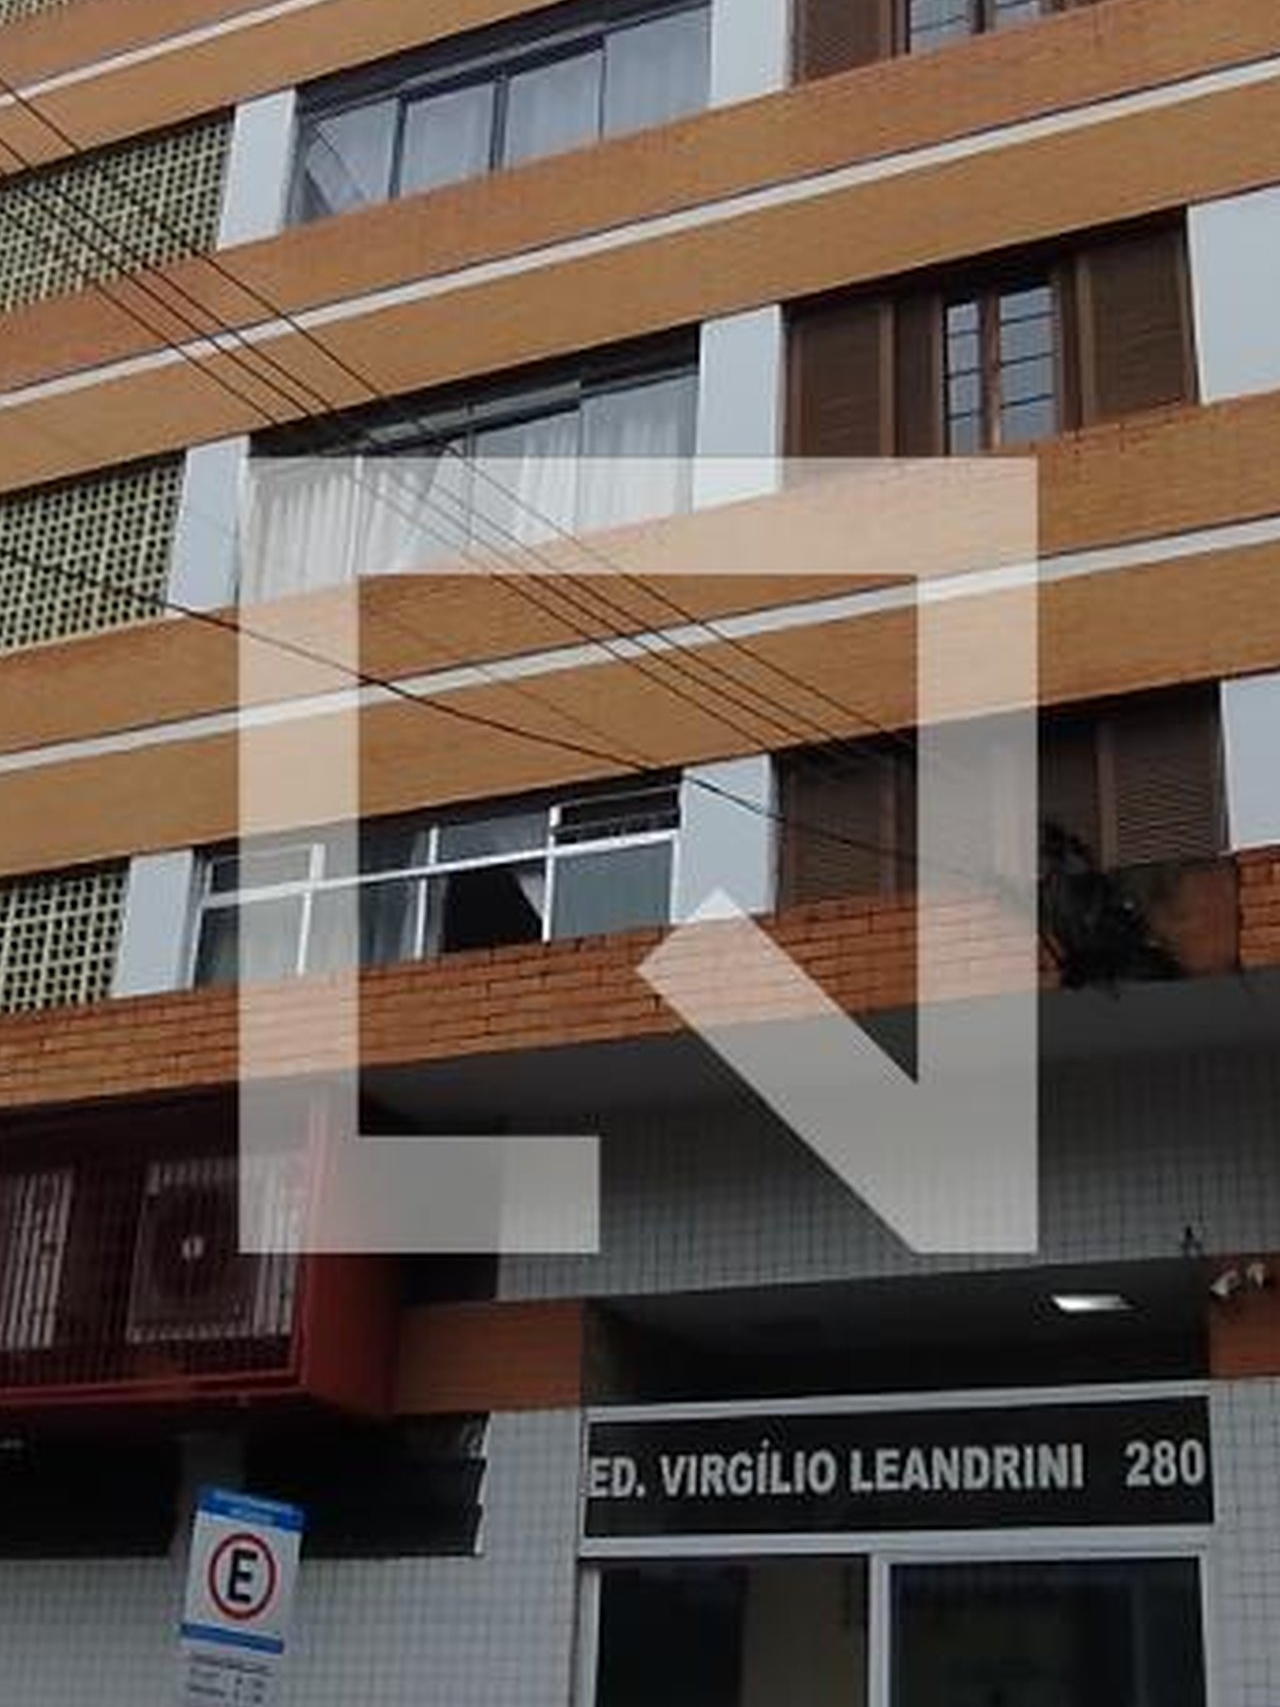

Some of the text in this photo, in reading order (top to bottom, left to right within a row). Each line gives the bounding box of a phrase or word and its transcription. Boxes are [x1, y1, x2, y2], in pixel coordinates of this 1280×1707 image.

[588, 1437, 1206, 1498] ED. VIRGÍLIO LEANDRINI 280
[227, 1548, 259, 1604] E
